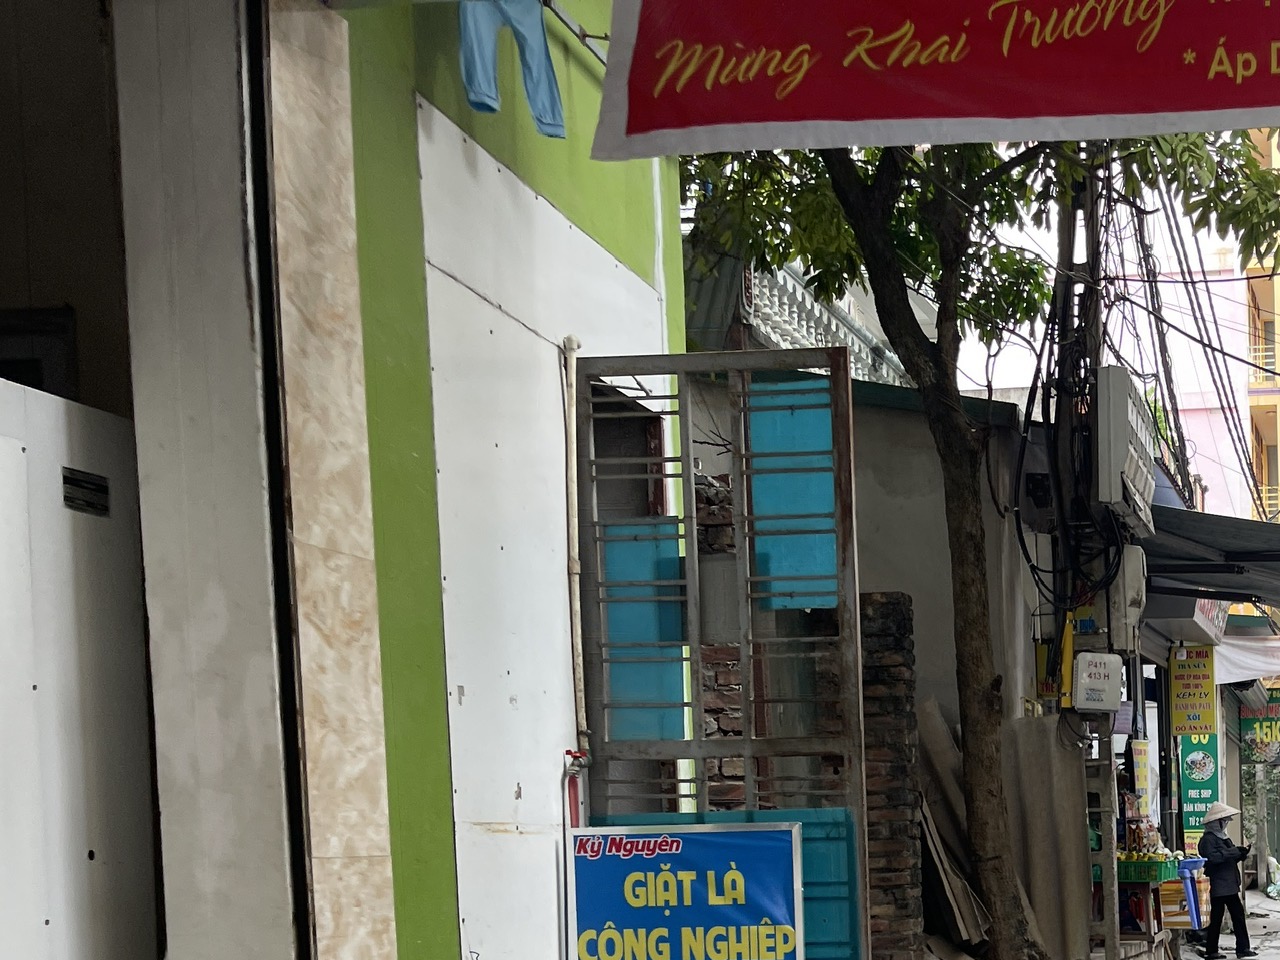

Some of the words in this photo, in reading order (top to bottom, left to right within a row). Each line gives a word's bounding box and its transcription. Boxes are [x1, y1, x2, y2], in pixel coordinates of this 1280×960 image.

[653, 38, 823, 100] Mừng
[843, 20, 970, 71] Khai
[1206, 35, 1257, 84] Áp
[1087, 661, 1107, 669] P411
[1087, 672, 1101, 680] 413
[1176, 691, 1196, 700] KEM
[1199, 691, 1209, 699] LY
[1186, 712, 1201, 721] XÔI
[1253, 721, 1280, 743] 15K
[1188, 790, 1200, 799] FREE
[606, 834, 682, 858] Nguyên
[624, 862, 697, 916] GIẶT
[707, 861, 746, 906] LÀ
